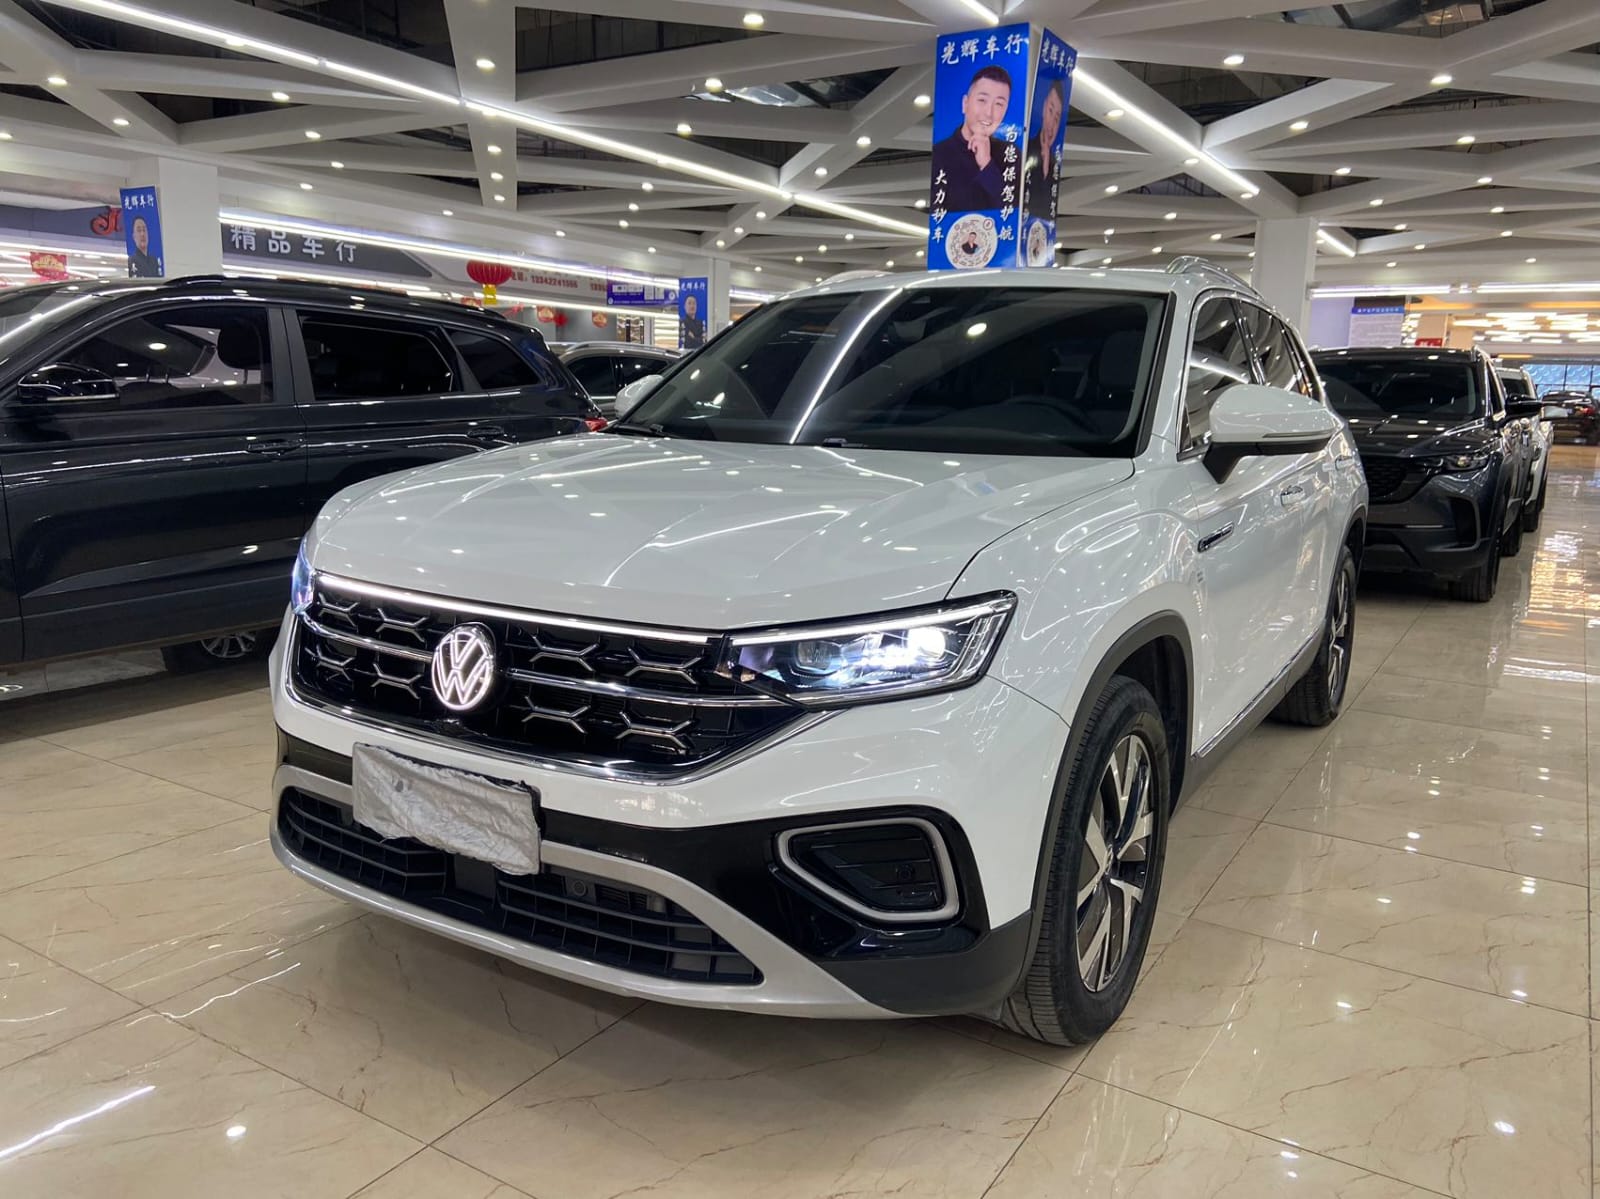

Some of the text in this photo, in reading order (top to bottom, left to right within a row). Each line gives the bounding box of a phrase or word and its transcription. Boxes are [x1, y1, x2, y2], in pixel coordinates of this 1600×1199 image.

[941, 33, 1023, 65] 光辉车行
[230, 222, 357, 263] 精品车行
